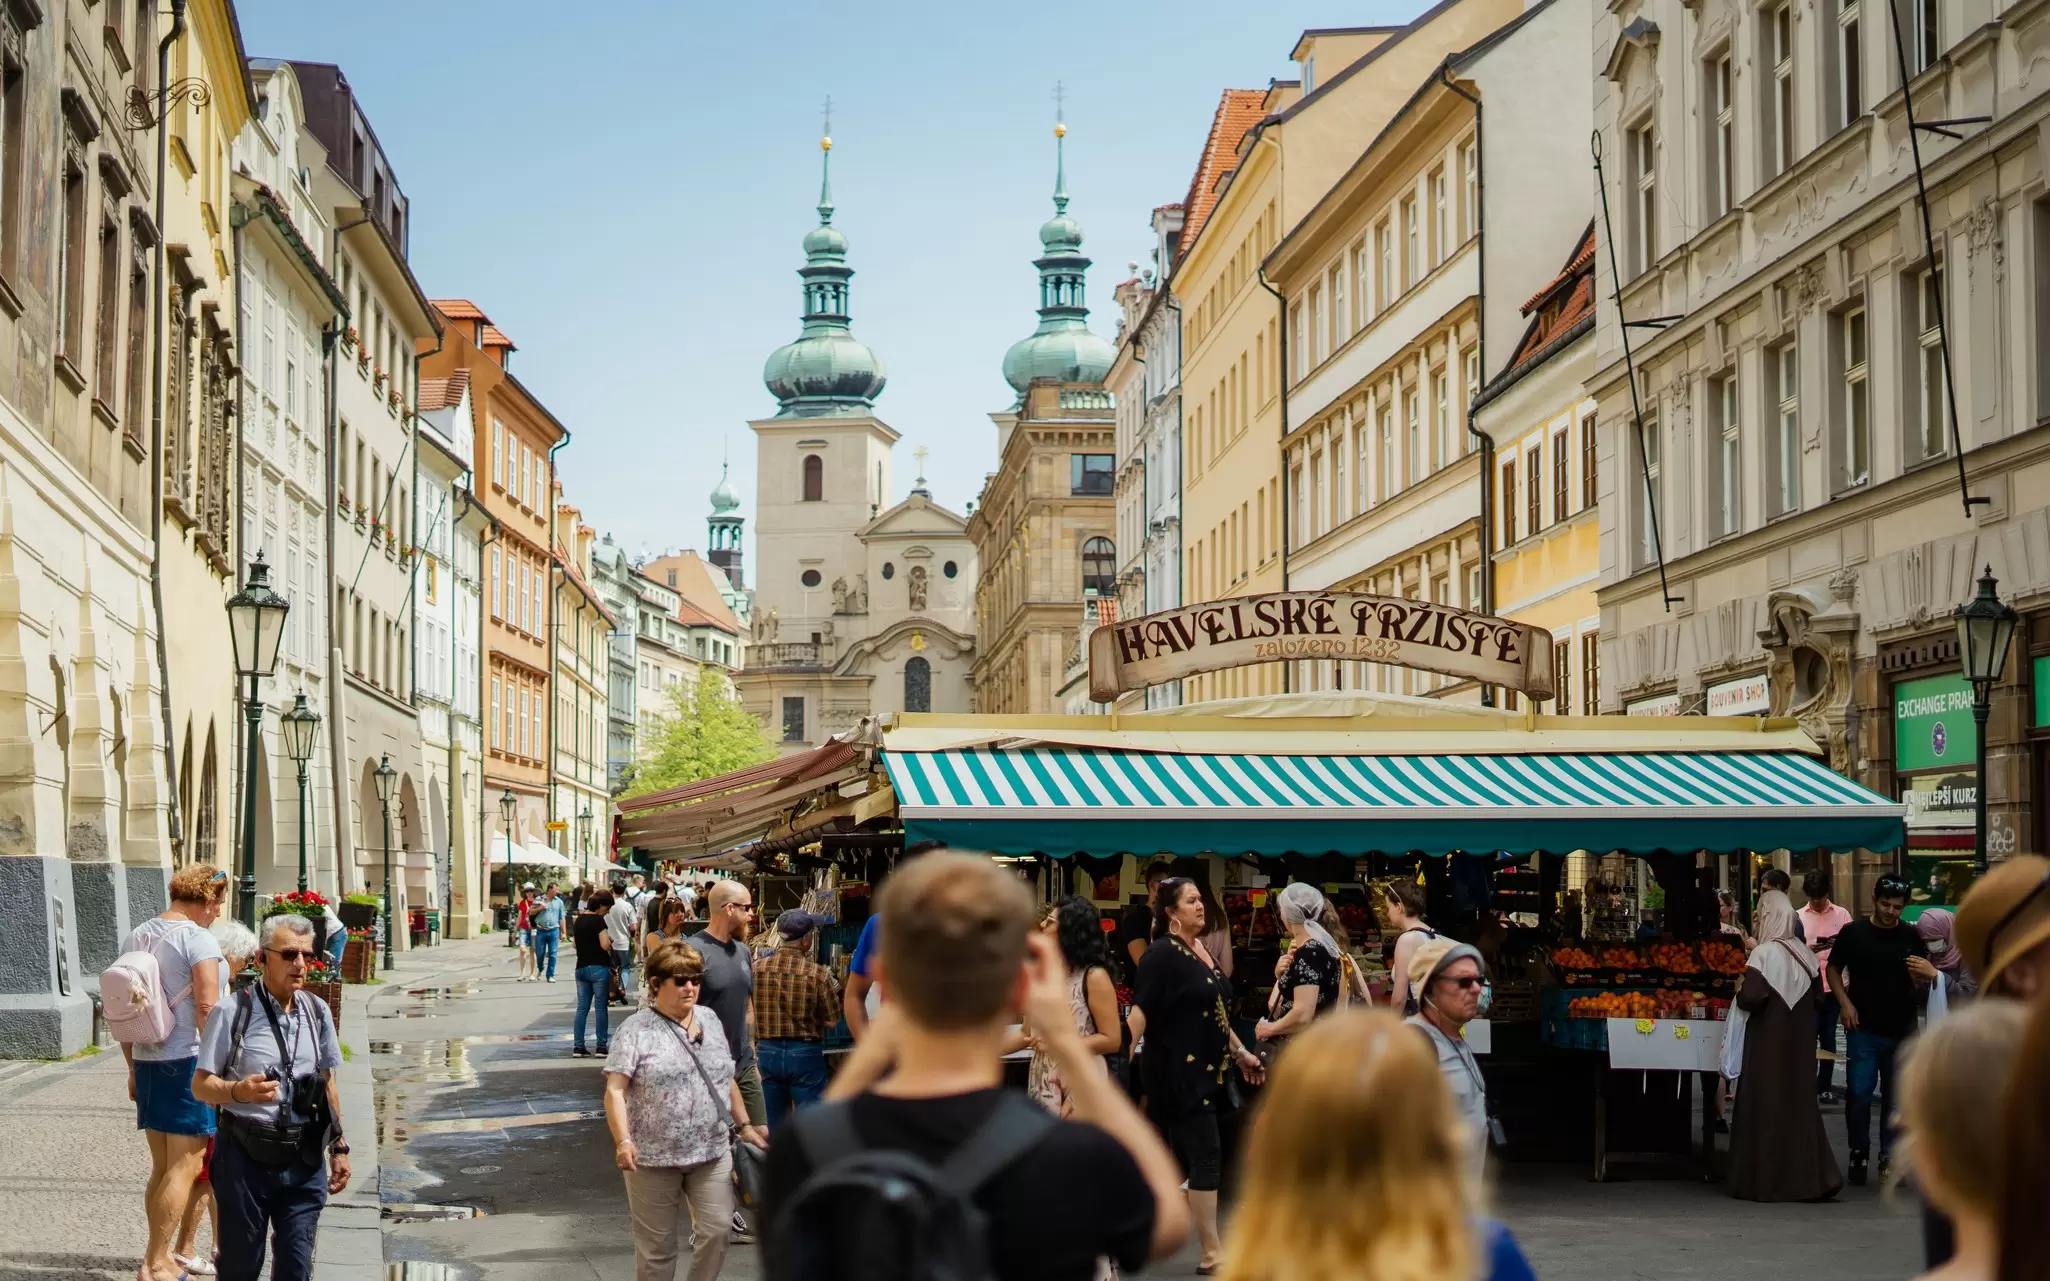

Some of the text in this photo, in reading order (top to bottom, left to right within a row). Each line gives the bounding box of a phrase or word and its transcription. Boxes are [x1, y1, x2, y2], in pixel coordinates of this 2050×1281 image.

[1115, 592, 1523, 665] HAVELSKÉ TRŽIŠTĚ
[1351, 636, 1400, 660] 1232
[1711, 682, 1765, 709] SOUVENIR SHOP
[1897, 689, 1975, 719] EXCHANGE PRAH
[1913, 785, 1977, 810] NEJLEPŠÍ KURZ
